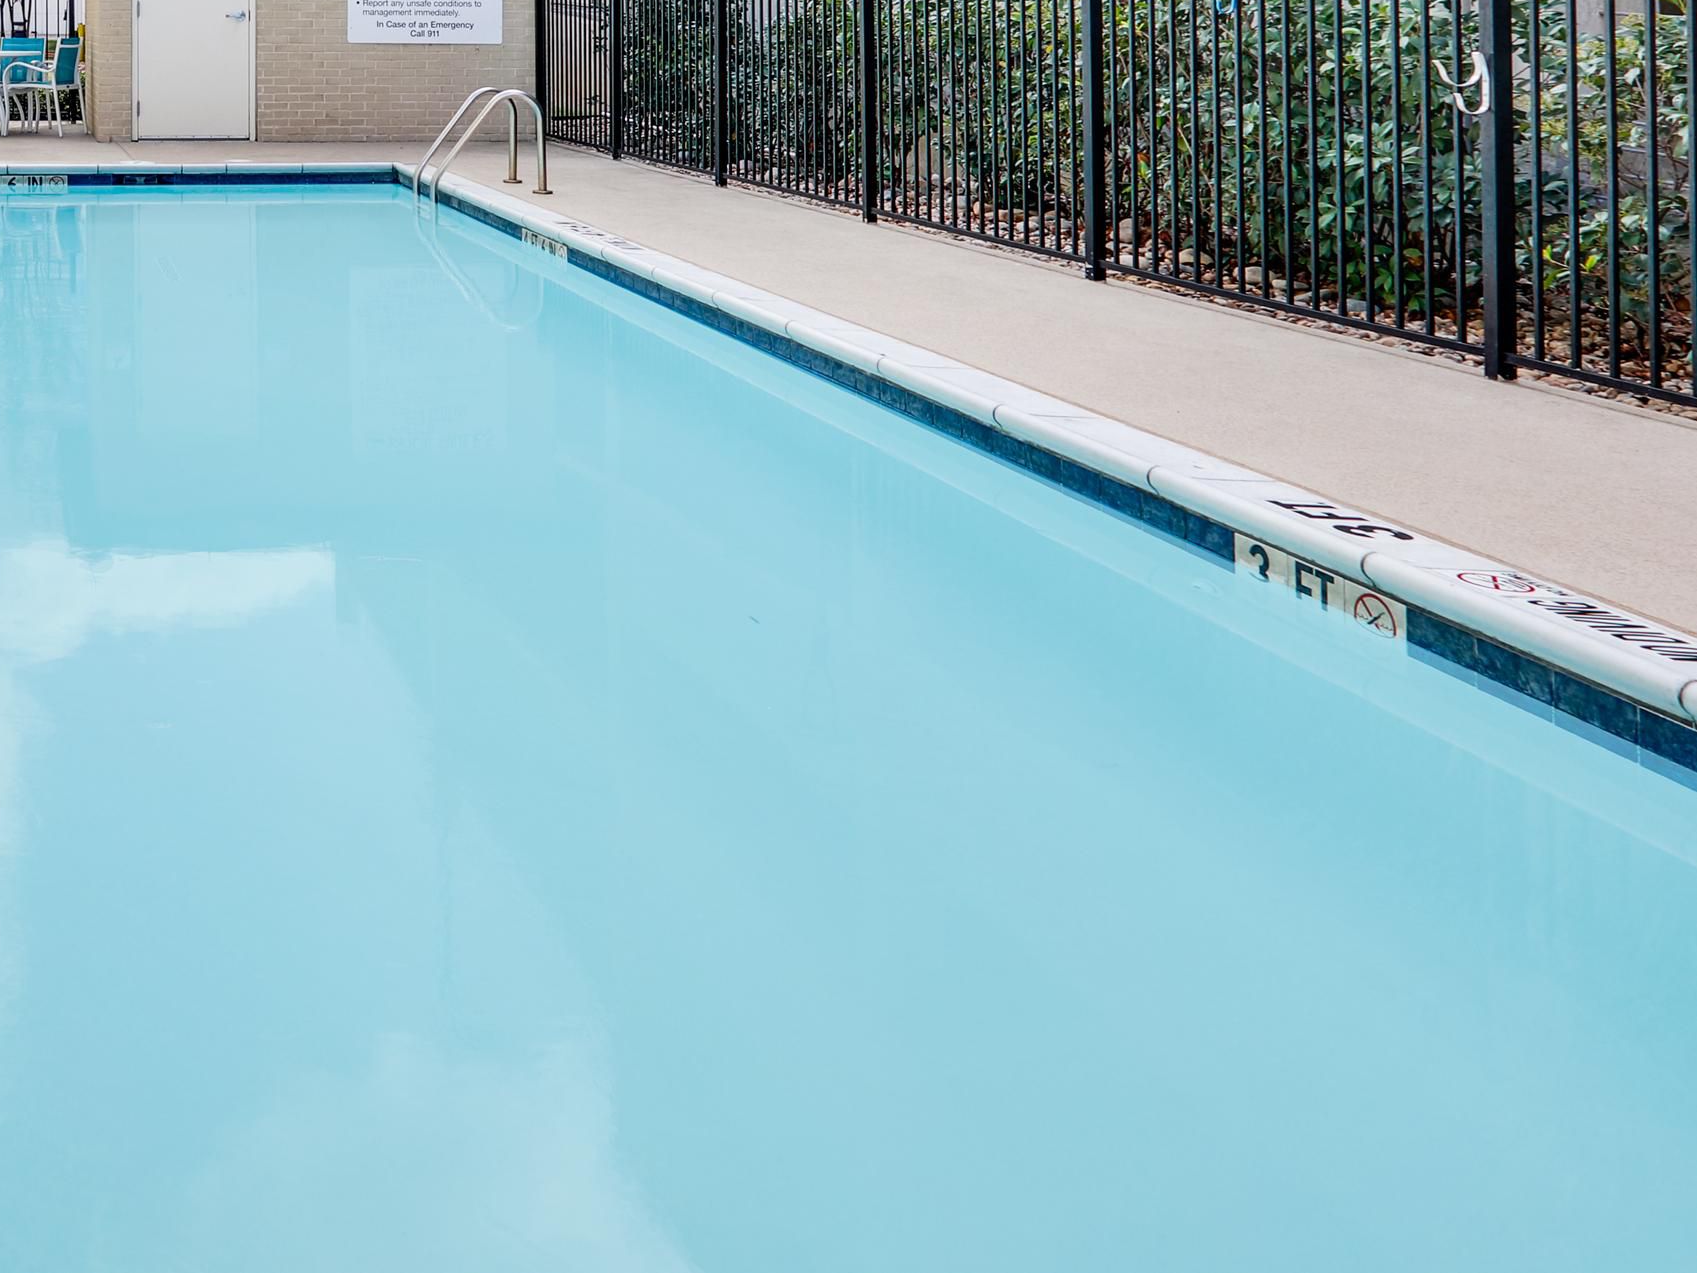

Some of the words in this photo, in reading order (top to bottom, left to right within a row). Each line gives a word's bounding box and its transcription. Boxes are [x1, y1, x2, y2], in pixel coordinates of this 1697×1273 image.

[363, 9, 411, 17] management
[414, 9, 460, 17] immediately.
[431, 21, 474, 30] Emergency
[27, 176, 43, 186] IN
[1332, 524, 1414, 540] 3
[1249, 544, 1270, 582] 3
[1295, 560, 1335, 612] FT
[1527, 600, 1691, 644] DIVING
